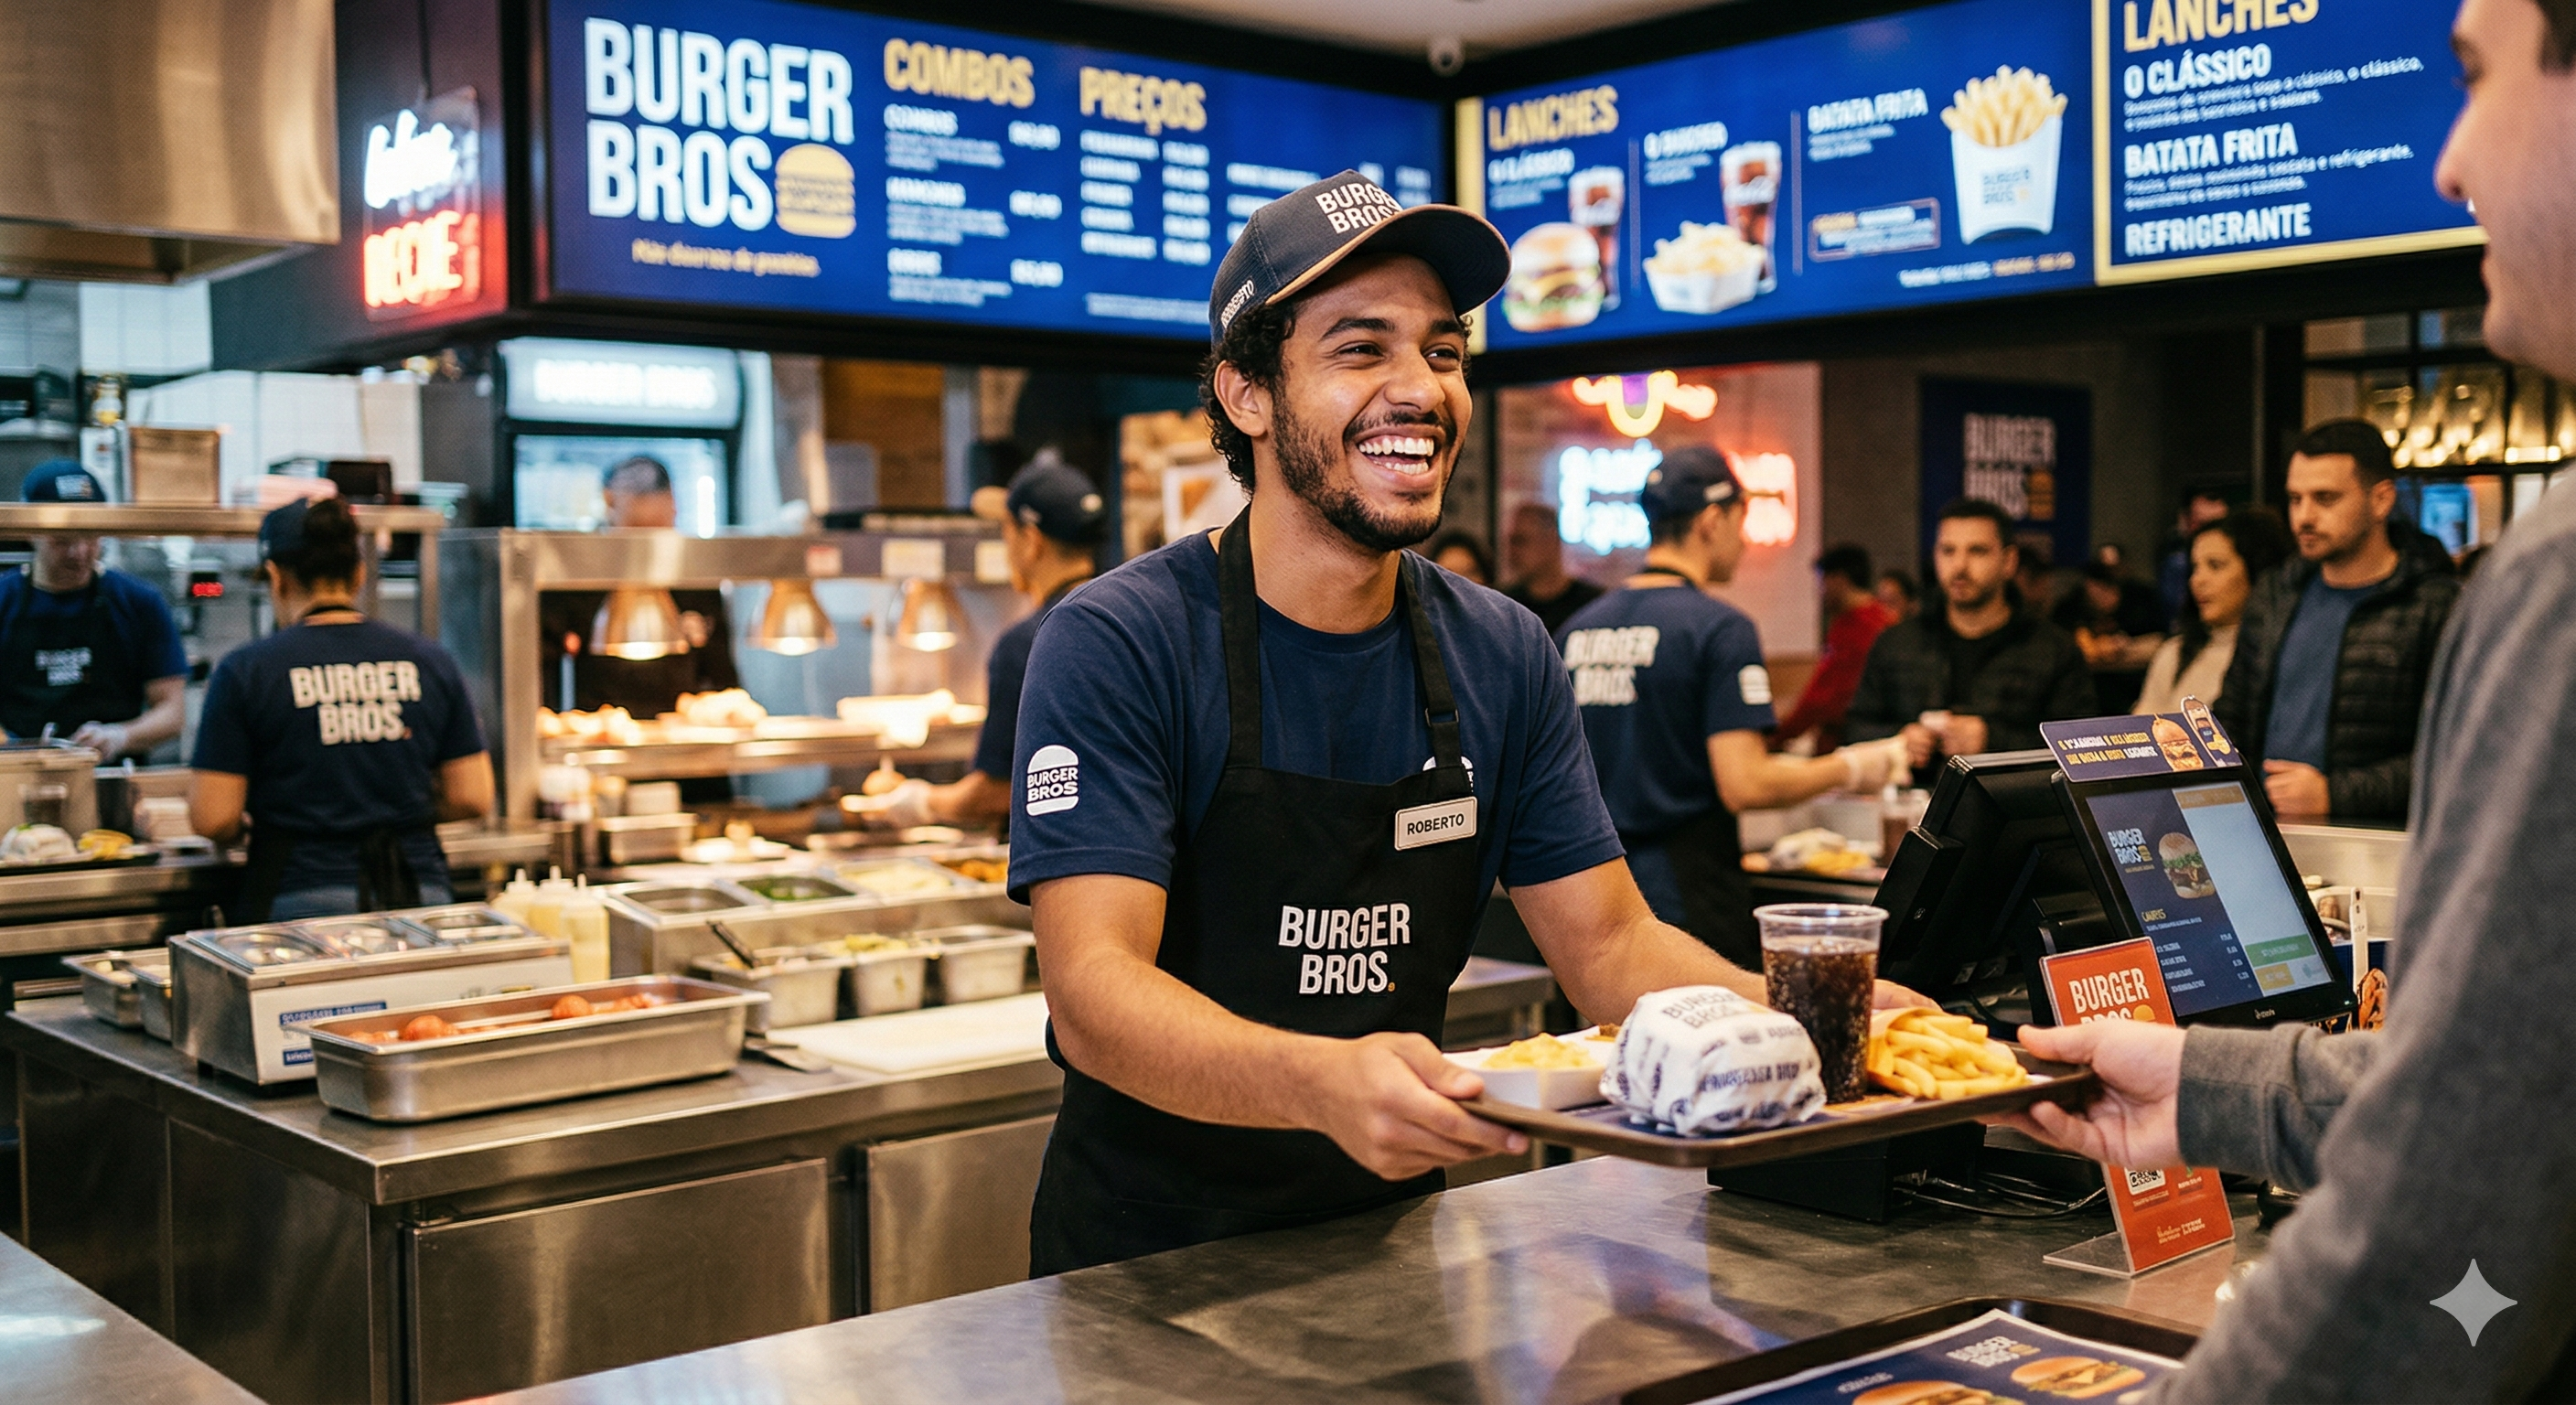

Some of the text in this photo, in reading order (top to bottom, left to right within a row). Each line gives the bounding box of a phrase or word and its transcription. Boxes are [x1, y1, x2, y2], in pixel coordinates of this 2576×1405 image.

[585, 16, 855, 145] BURGER
[884, 38, 1036, 108] COMBOS
[2124, 64, 2144, 99] O
[2147, 43, 2271, 95] CLÁSSICO
[1079, 66, 1208, 136] PREÇOS
[1488, 84, 1619, 152] LANCHES
[587, 119, 774, 231] BROS
[2124, 134, 2220, 178] BATATA
[2223, 122, 2299, 165] FRITA
[2124, 202, 2313, 257] REFRIGERANTE
[289, 660, 422, 708] BURGER
[1027, 767, 1079, 788] BURGER
[1027, 781, 1079, 802] BROS
[1406, 813, 1465, 836] ROBERTO
[1278, 903, 1411, 950] BURGER
[2068, 967, 2150, 1014] BURGER
